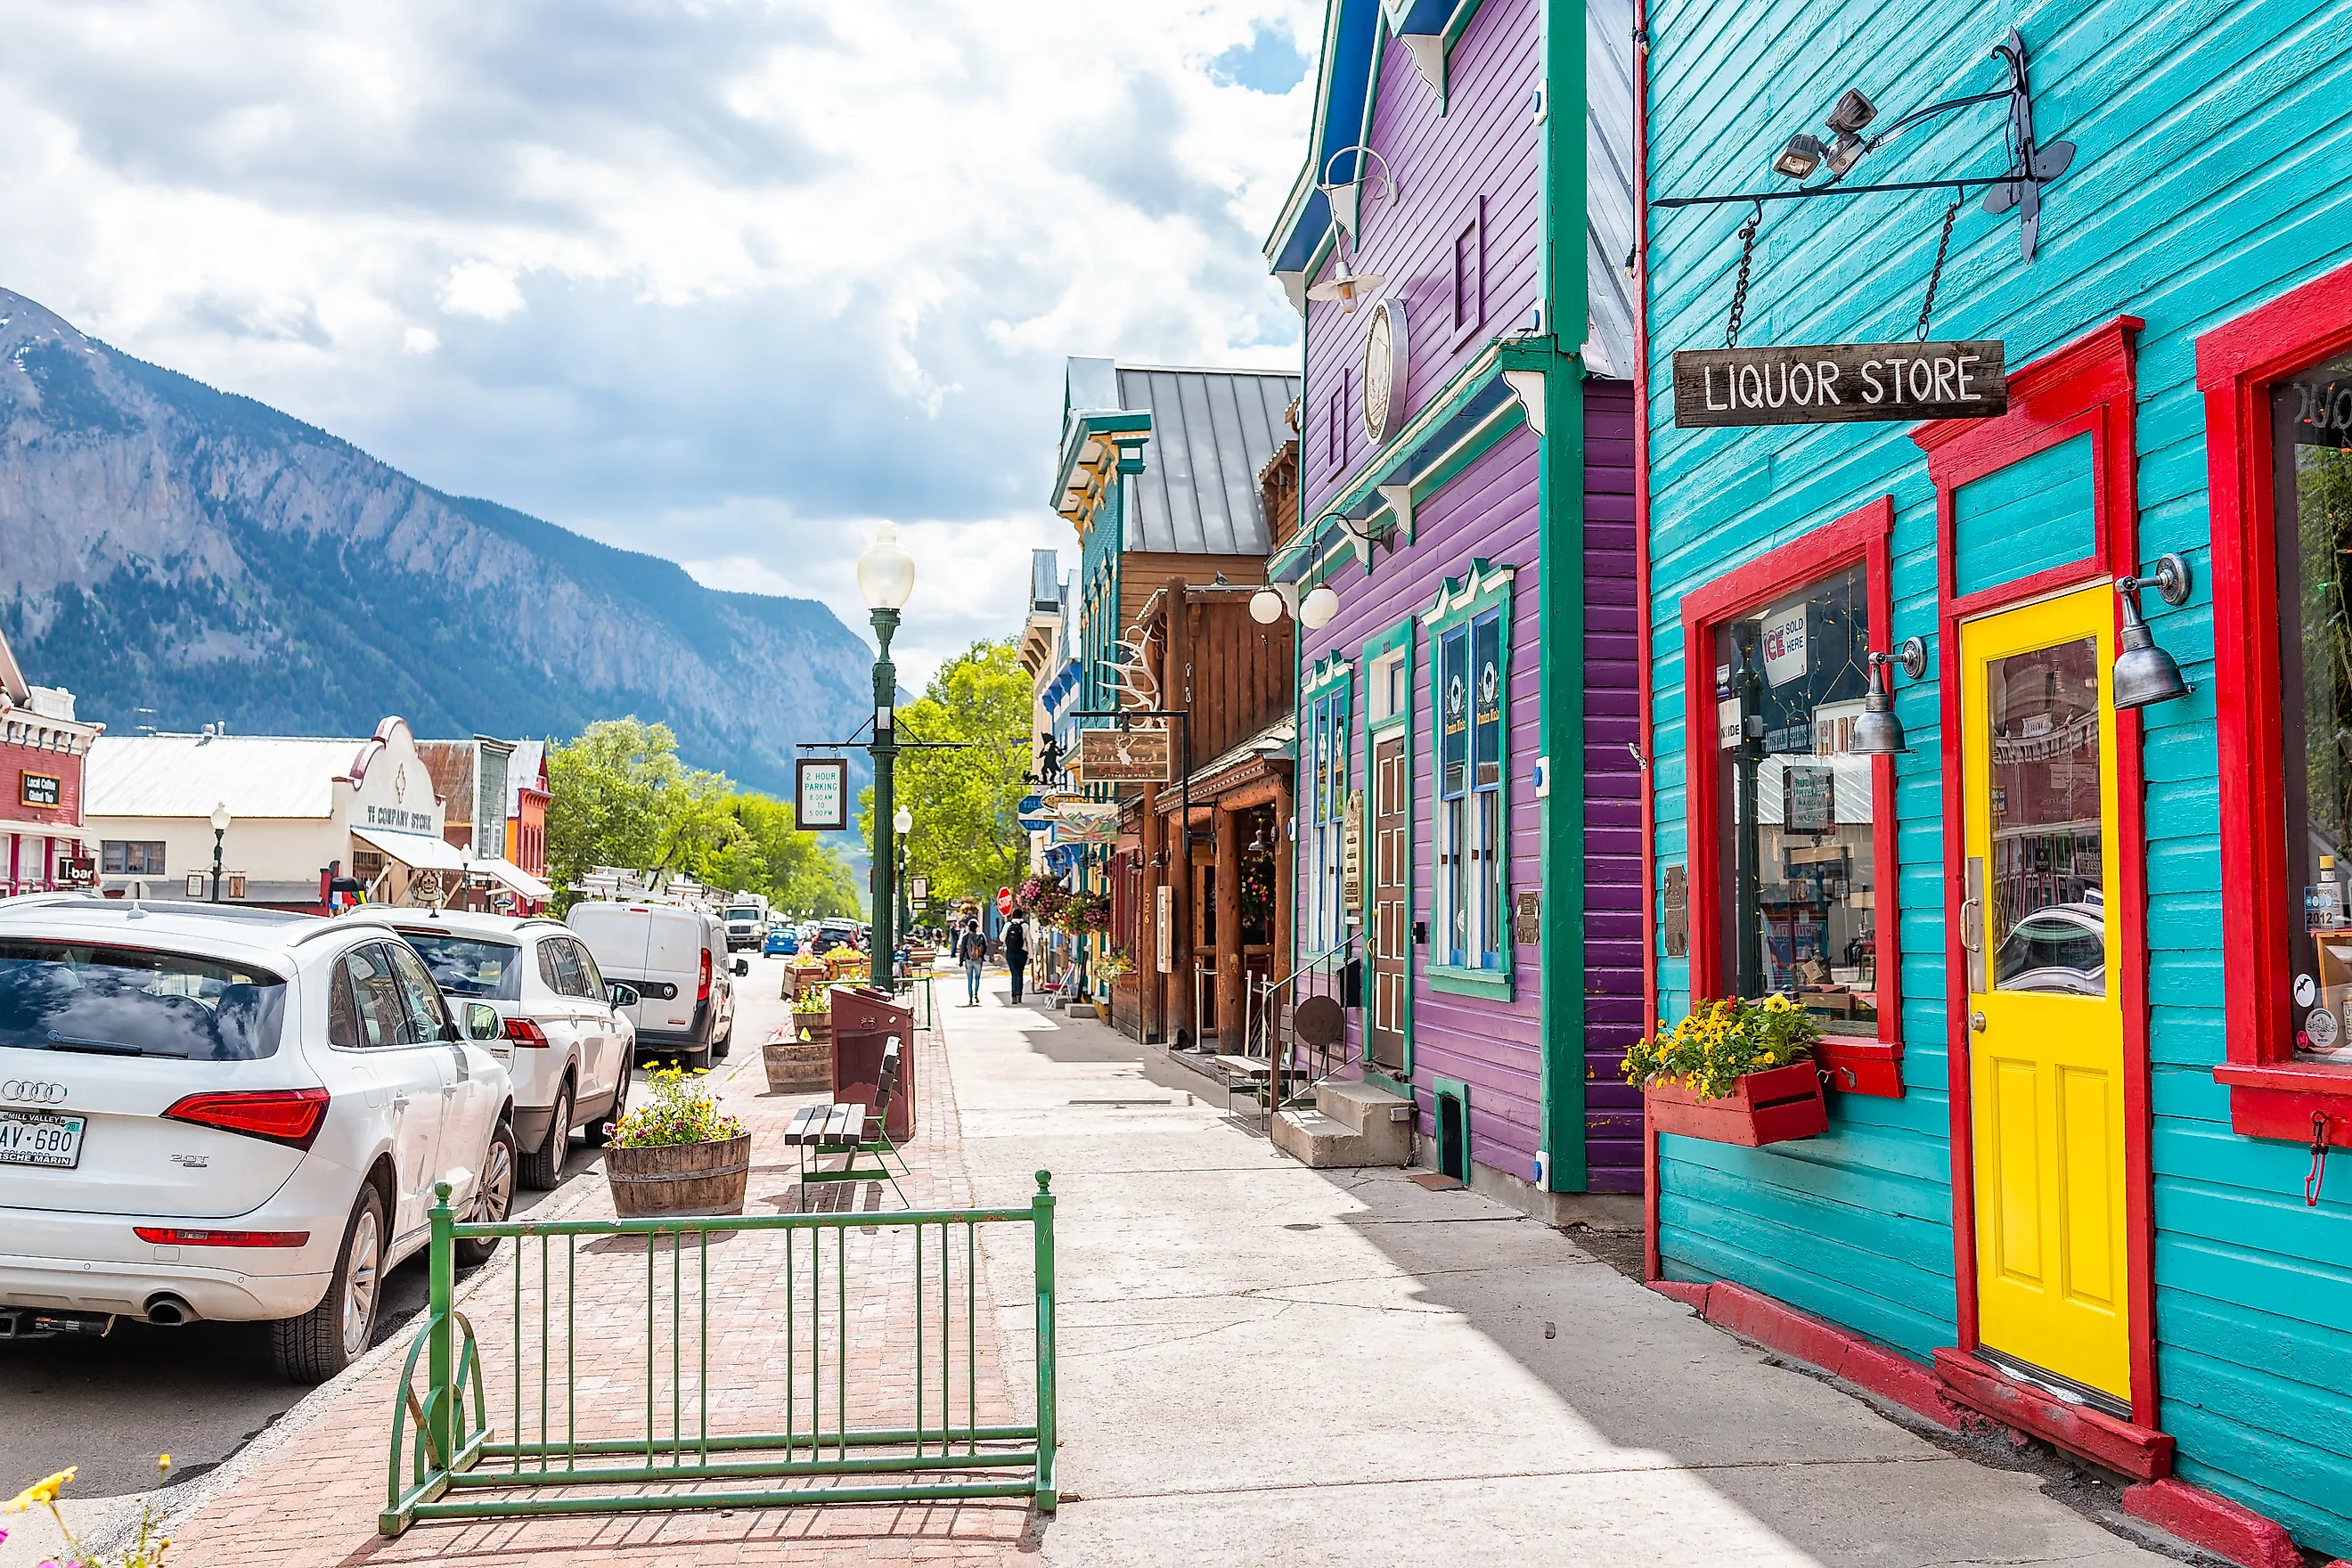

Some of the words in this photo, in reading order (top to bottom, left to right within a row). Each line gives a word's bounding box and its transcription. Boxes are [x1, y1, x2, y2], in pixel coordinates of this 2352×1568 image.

[1704, 360, 1841, 411] LIQUOR
[1861, 355, 1982, 404] STORE
[1785, 617, 1804, 635] SOLD
[1762, 625, 1786, 663] ICE
[1785, 635, 1804, 653] HERE
[805, 772, 812, 780] 2
[815, 772, 836, 780] HOUR
[1098, 764, 1153, 774] PRIME
[27, 776, 41, 788] Local
[41, 778, 56, 791] Coffee
[804, 783, 837, 791] PARKING
[29, 790, 44, 802] Global
[45, 791, 54, 804] Tea
[378, 807, 409, 828] COMPANY
[412, 813, 432, 831] STORE
[1025, 821, 1047, 829] TOWN
[998, 894, 1012, 909] STOP
[2306, 911, 2333, 925] 2012
[8, 1113, 28, 1121] MILL
[29, 1115, 61, 1123] VALLEY
[34, 1156, 70, 1165] MARIN
[169, 1154, 209, 1164] 2.0T
